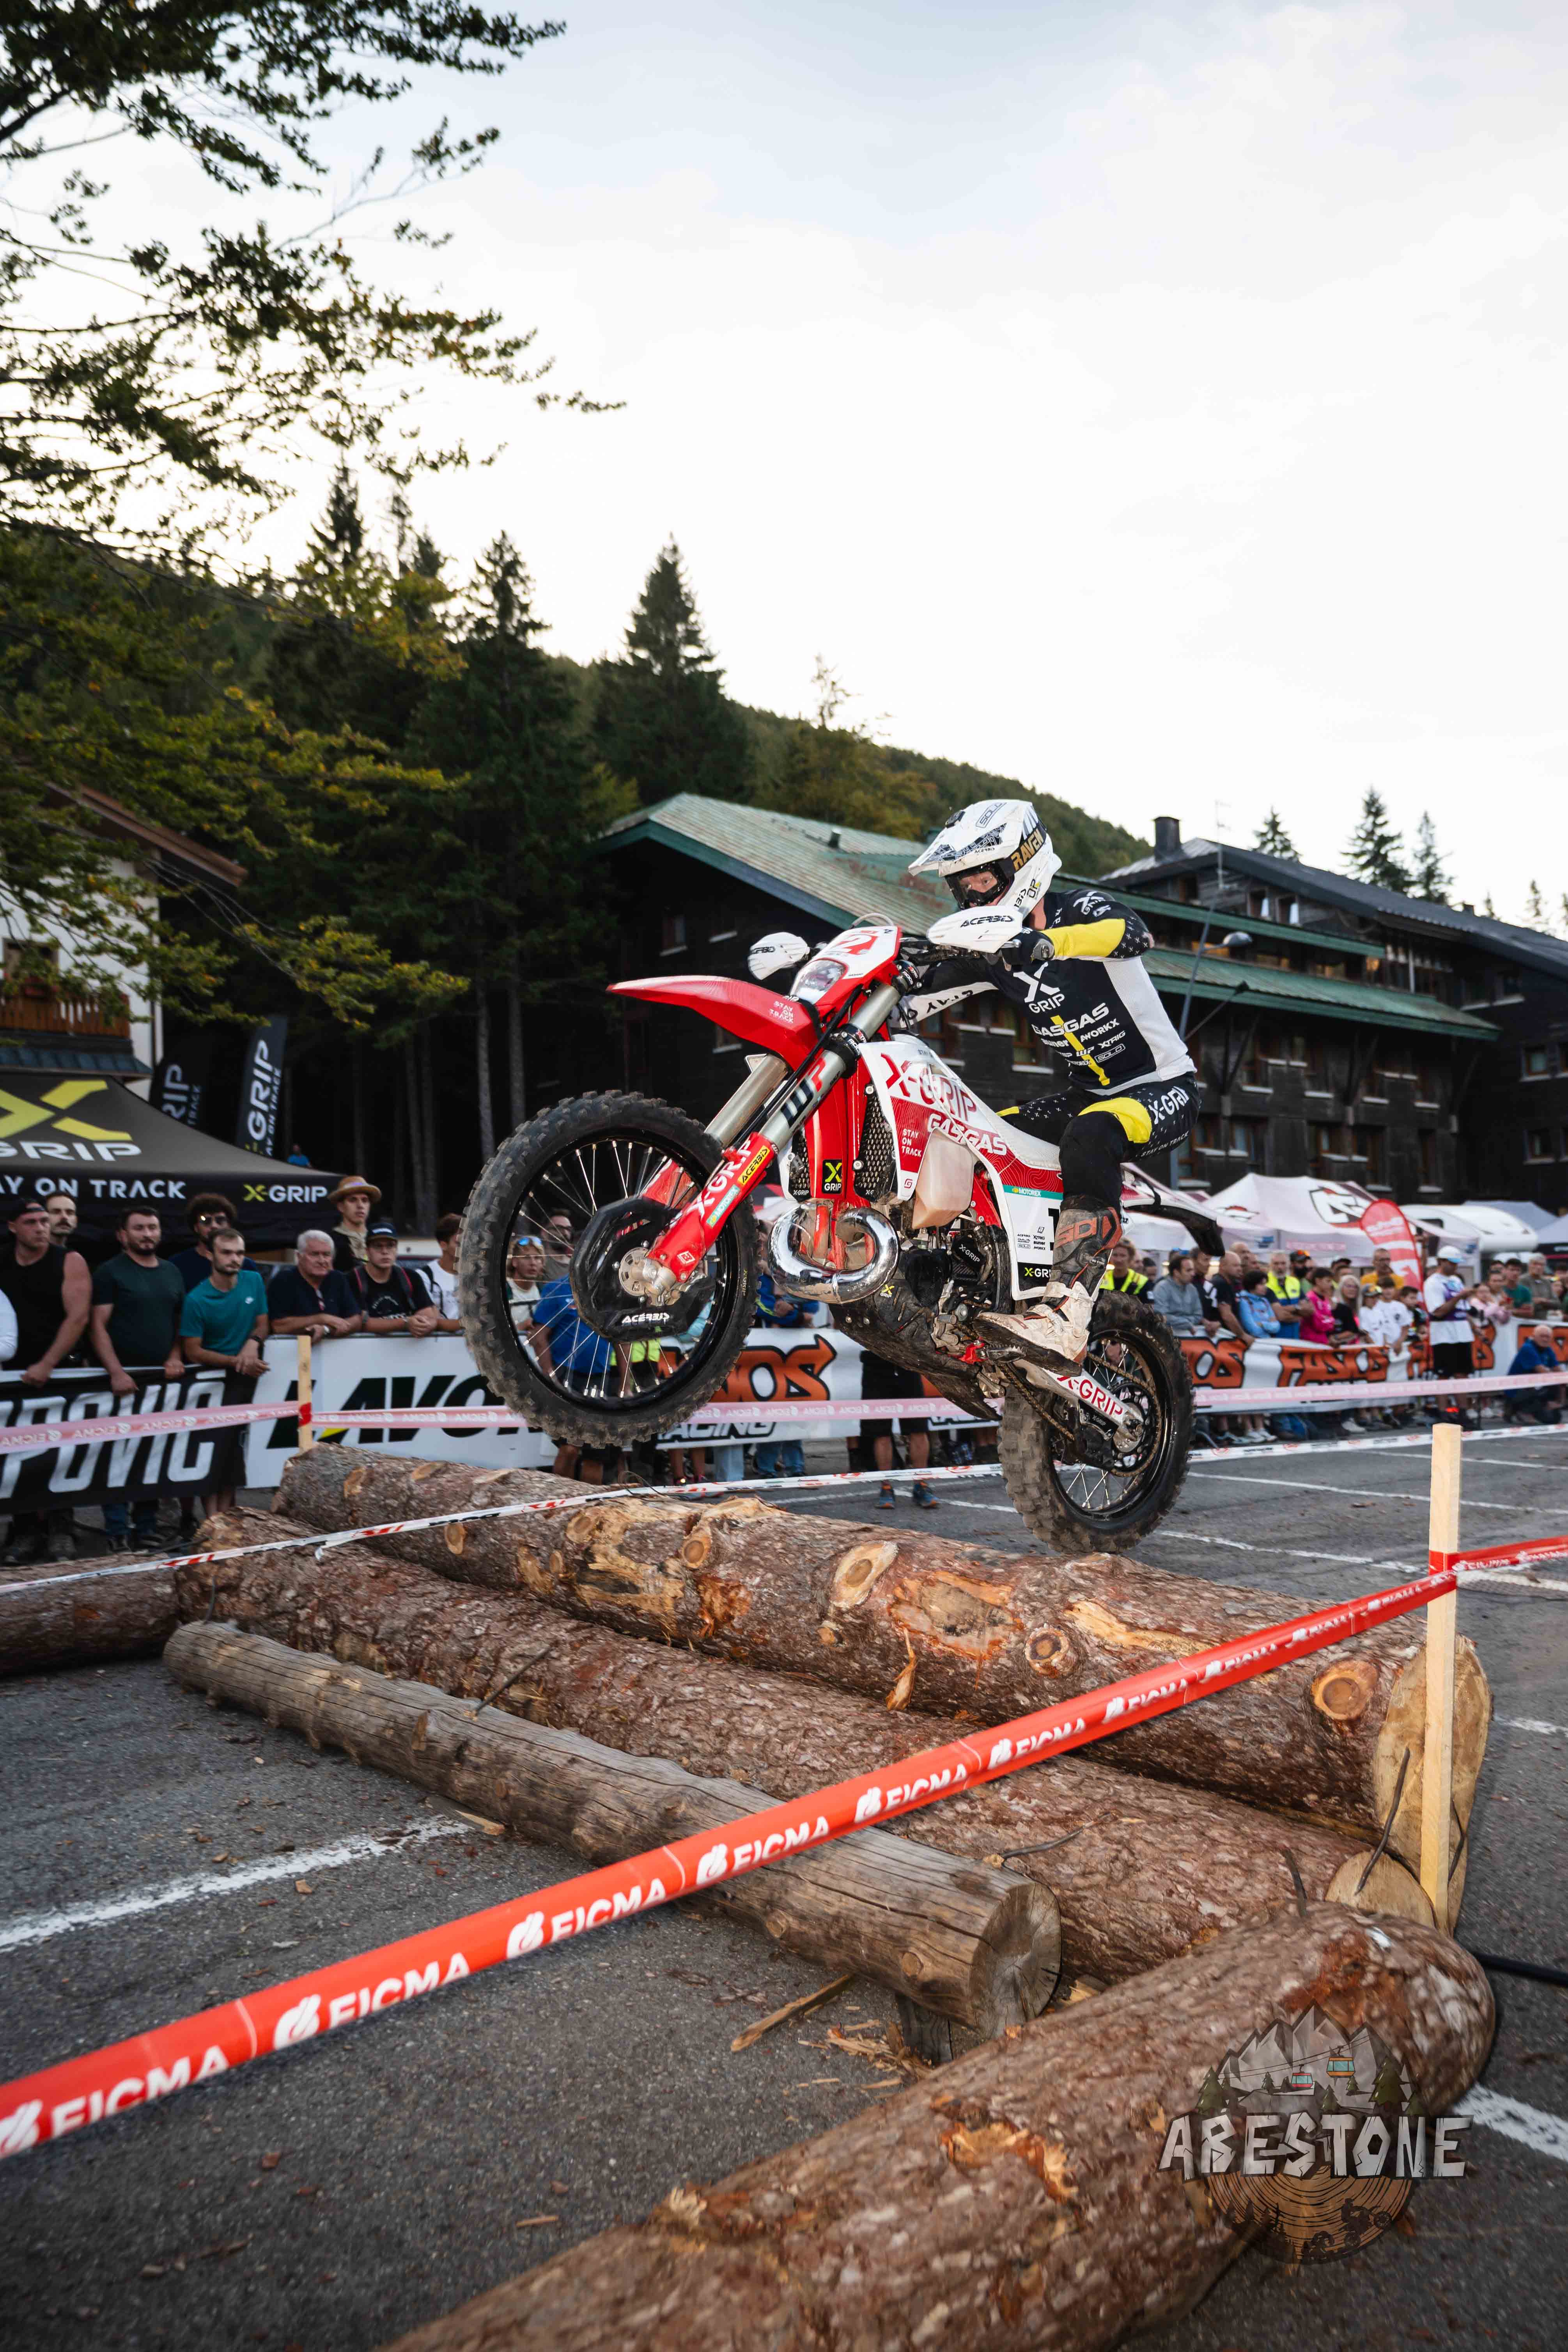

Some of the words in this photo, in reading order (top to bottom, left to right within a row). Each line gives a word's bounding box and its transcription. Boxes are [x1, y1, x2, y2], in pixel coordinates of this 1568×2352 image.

[773, 1001, 793, 1012] STAY
[1029, 994, 1065, 1014] GRIP
[769, 1009, 793, 1024] TRACK
[782, 1010, 794, 1018] ON
[1031, 1002, 1109, 1037] GASGAS
[1097, 1046, 1122, 1061] SOLO
[248, 1040, 273, 1141] GRIP
[901, 1137, 912, 1146] ON
[903, 1128, 919, 1139] STAY
[901, 1146, 922, 1157] TRACK
[1141, 1148, 1158, 1157] STAY
[1169, 1130, 1189, 1146] TRACK
[34, 1178, 78, 1198] ON
[89, 1179, 186, 1199] TRACK
[243, 1184, 328, 1203] X-GRIP
[824, 1183, 842, 1191] GRIP
[1019, 1188, 1042, 1197] MOTOREX
[959, 1243, 980, 1263] X-GRIP
[1057, 1375, 1123, 1415] X-GRIP
[1092, 1415, 1106, 1426] X-GRIP
[733, 1815, 829, 1872] EICMA
[551, 1878, 666, 1942] EICMA
[329, 1952, 470, 2028] EICMA
